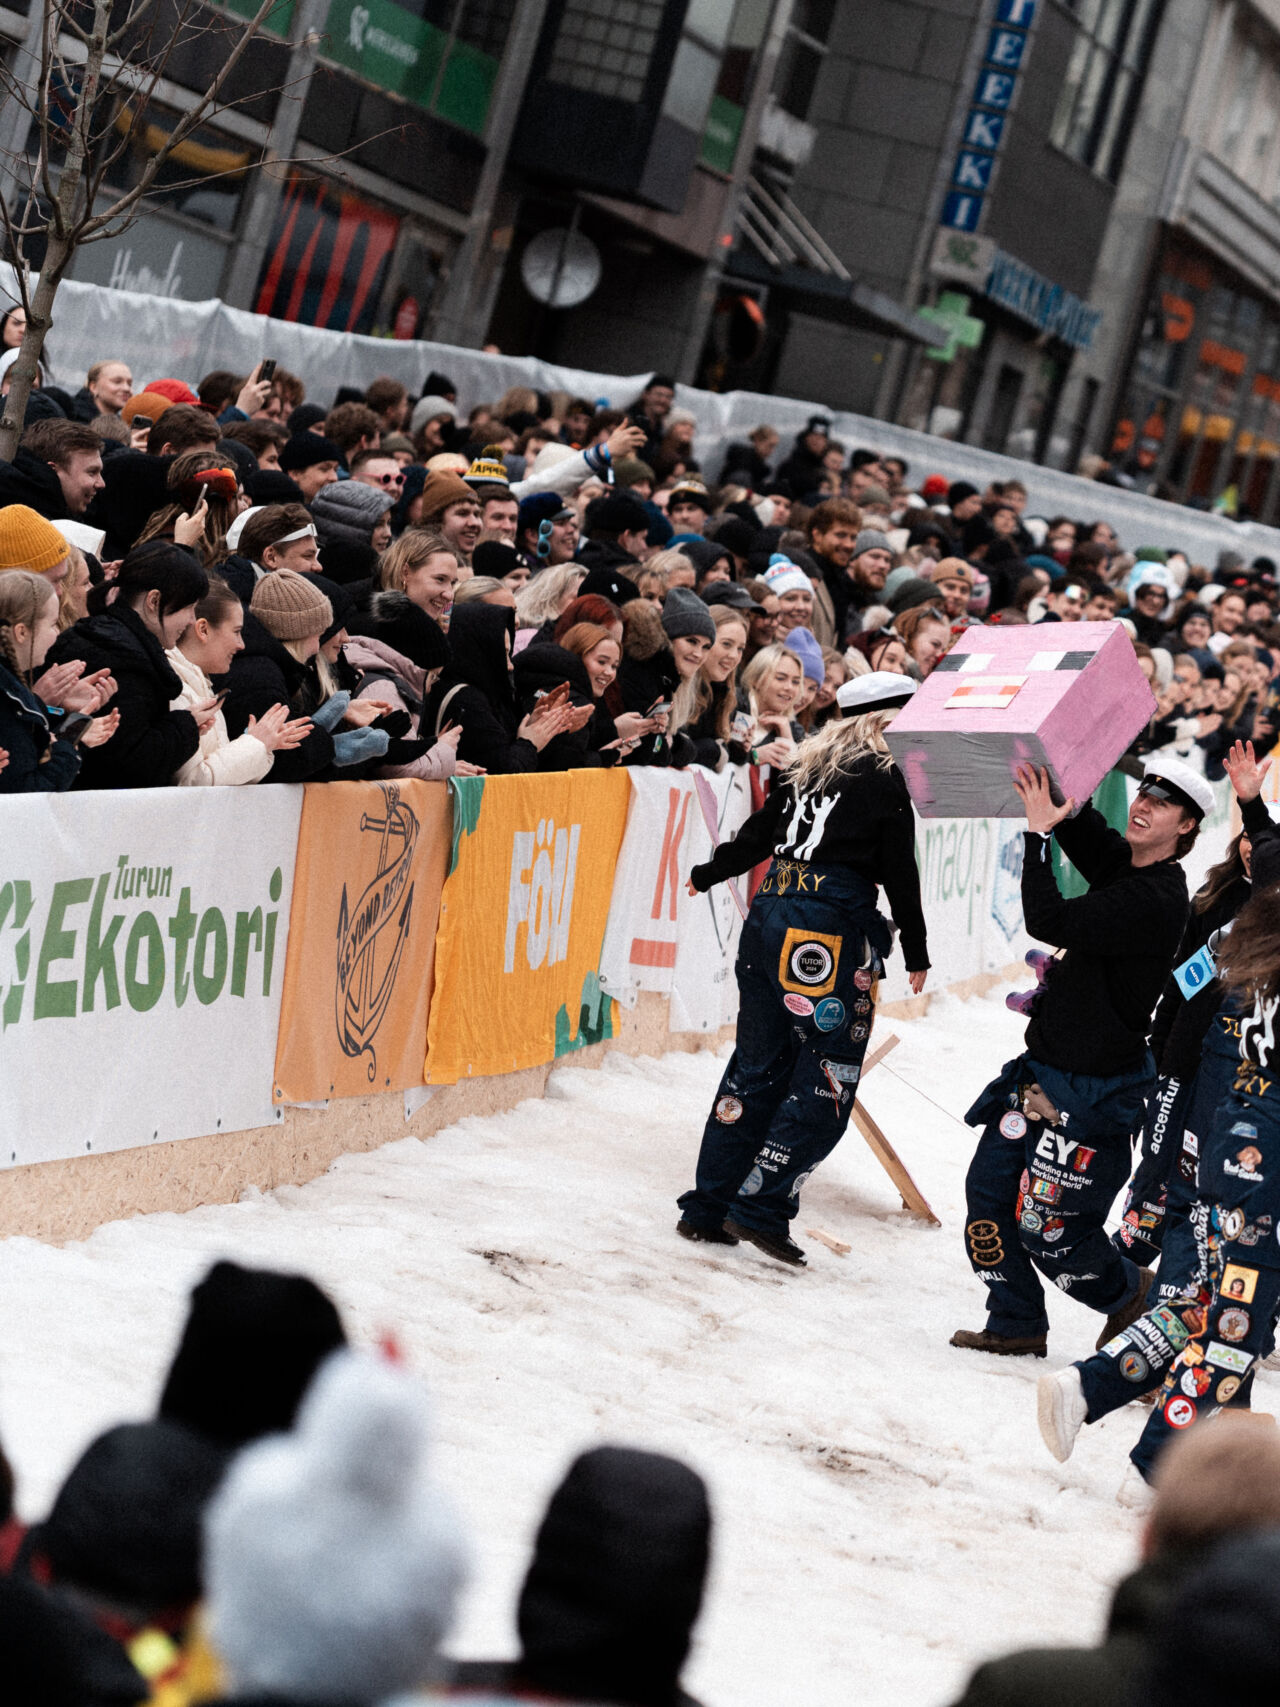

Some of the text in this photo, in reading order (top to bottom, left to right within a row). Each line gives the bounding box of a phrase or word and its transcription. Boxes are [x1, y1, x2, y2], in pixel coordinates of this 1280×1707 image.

[114, 855, 173, 899] Turun
[796, 872, 827, 892] KY
[32, 866, 283, 1022] Ekotori
[339, 892, 381, 994] BEYOND
[800, 957, 825, 967] TUTOR
[1151, 1076, 1181, 1155] accentur
[770, 1151, 790, 1165] ICE
[1035, 1128, 1080, 1166] EY
[1030, 1165, 1082, 1190] working world
[1032, 1157, 1061, 1177] Building
[1069, 1173, 1093, 1186] better
